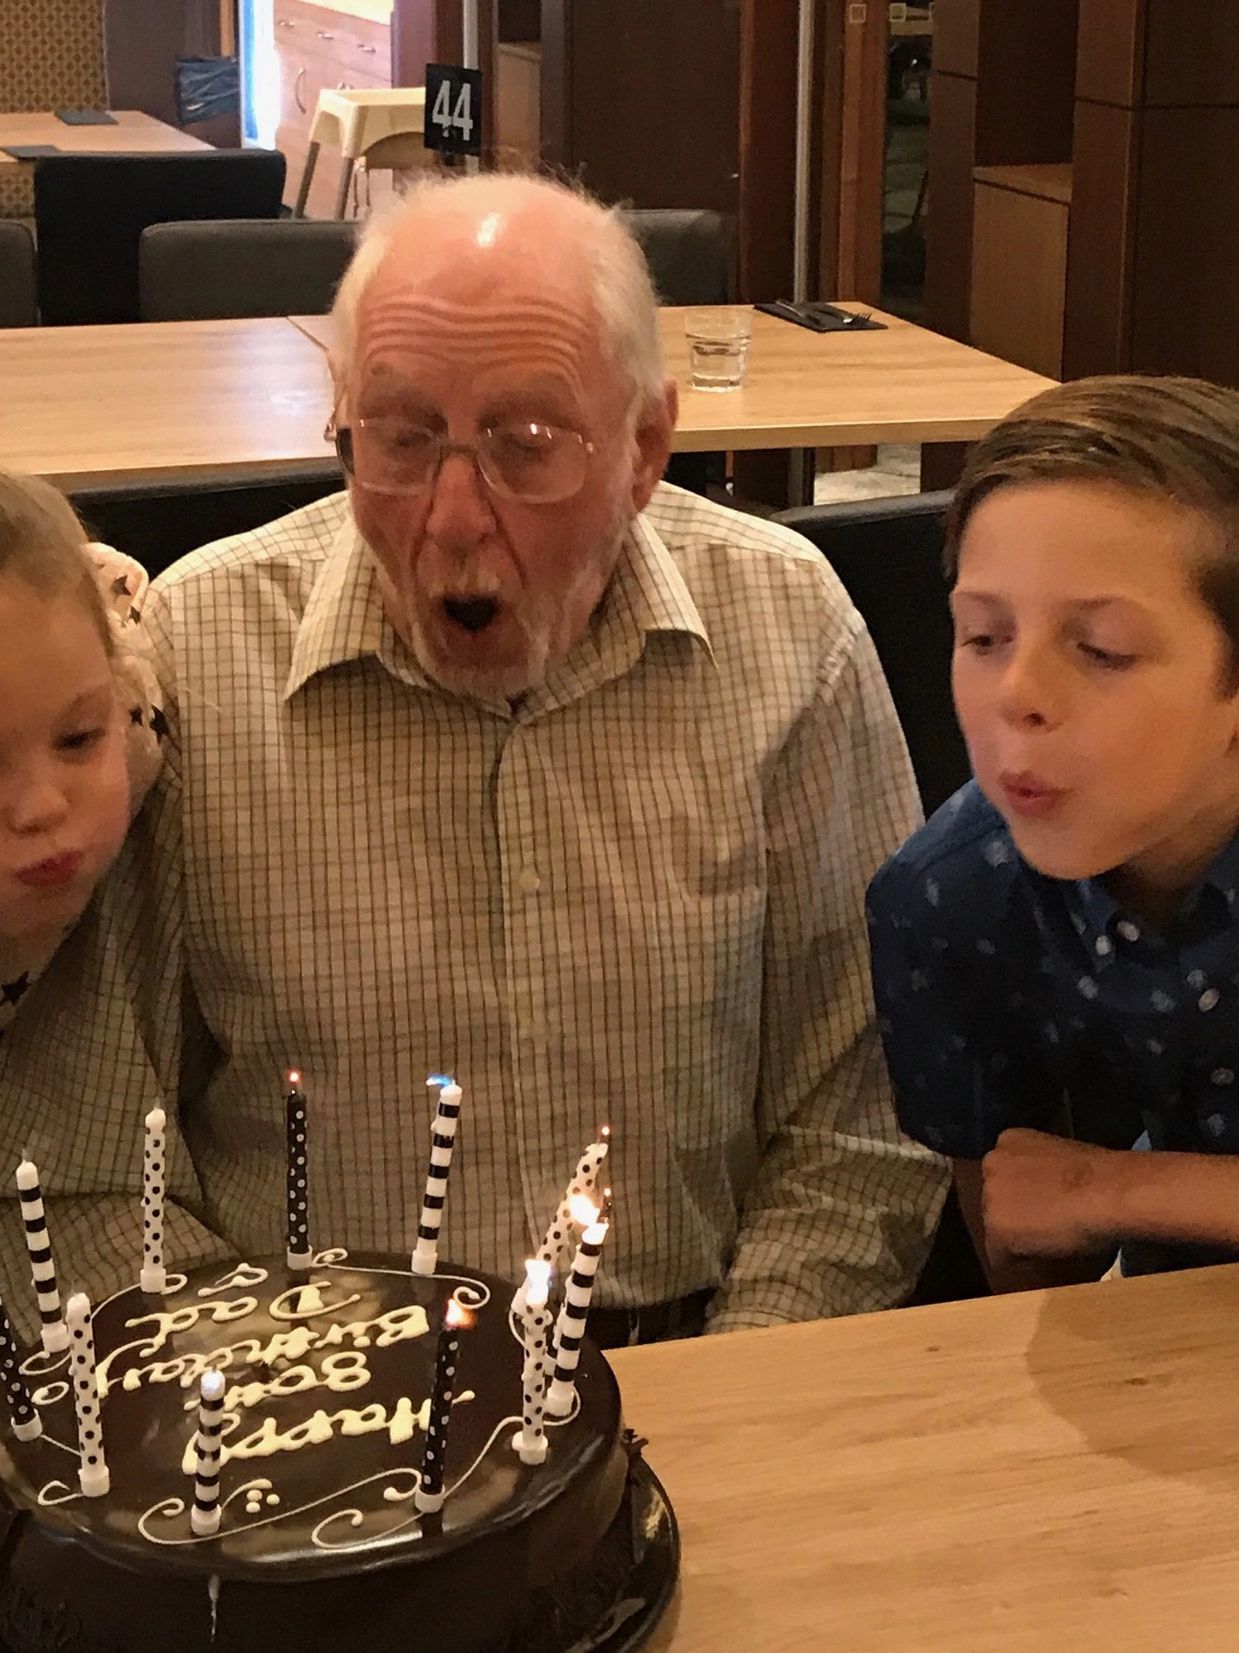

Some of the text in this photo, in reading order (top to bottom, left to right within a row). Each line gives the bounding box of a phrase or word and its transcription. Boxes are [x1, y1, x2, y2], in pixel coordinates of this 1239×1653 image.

[432, 80, 474, 141] 44
[95, 1305, 430, 1398] Birthday
[124, 1281, 361, 1357] Dad
[182, 1391, 476, 1476] Happy
